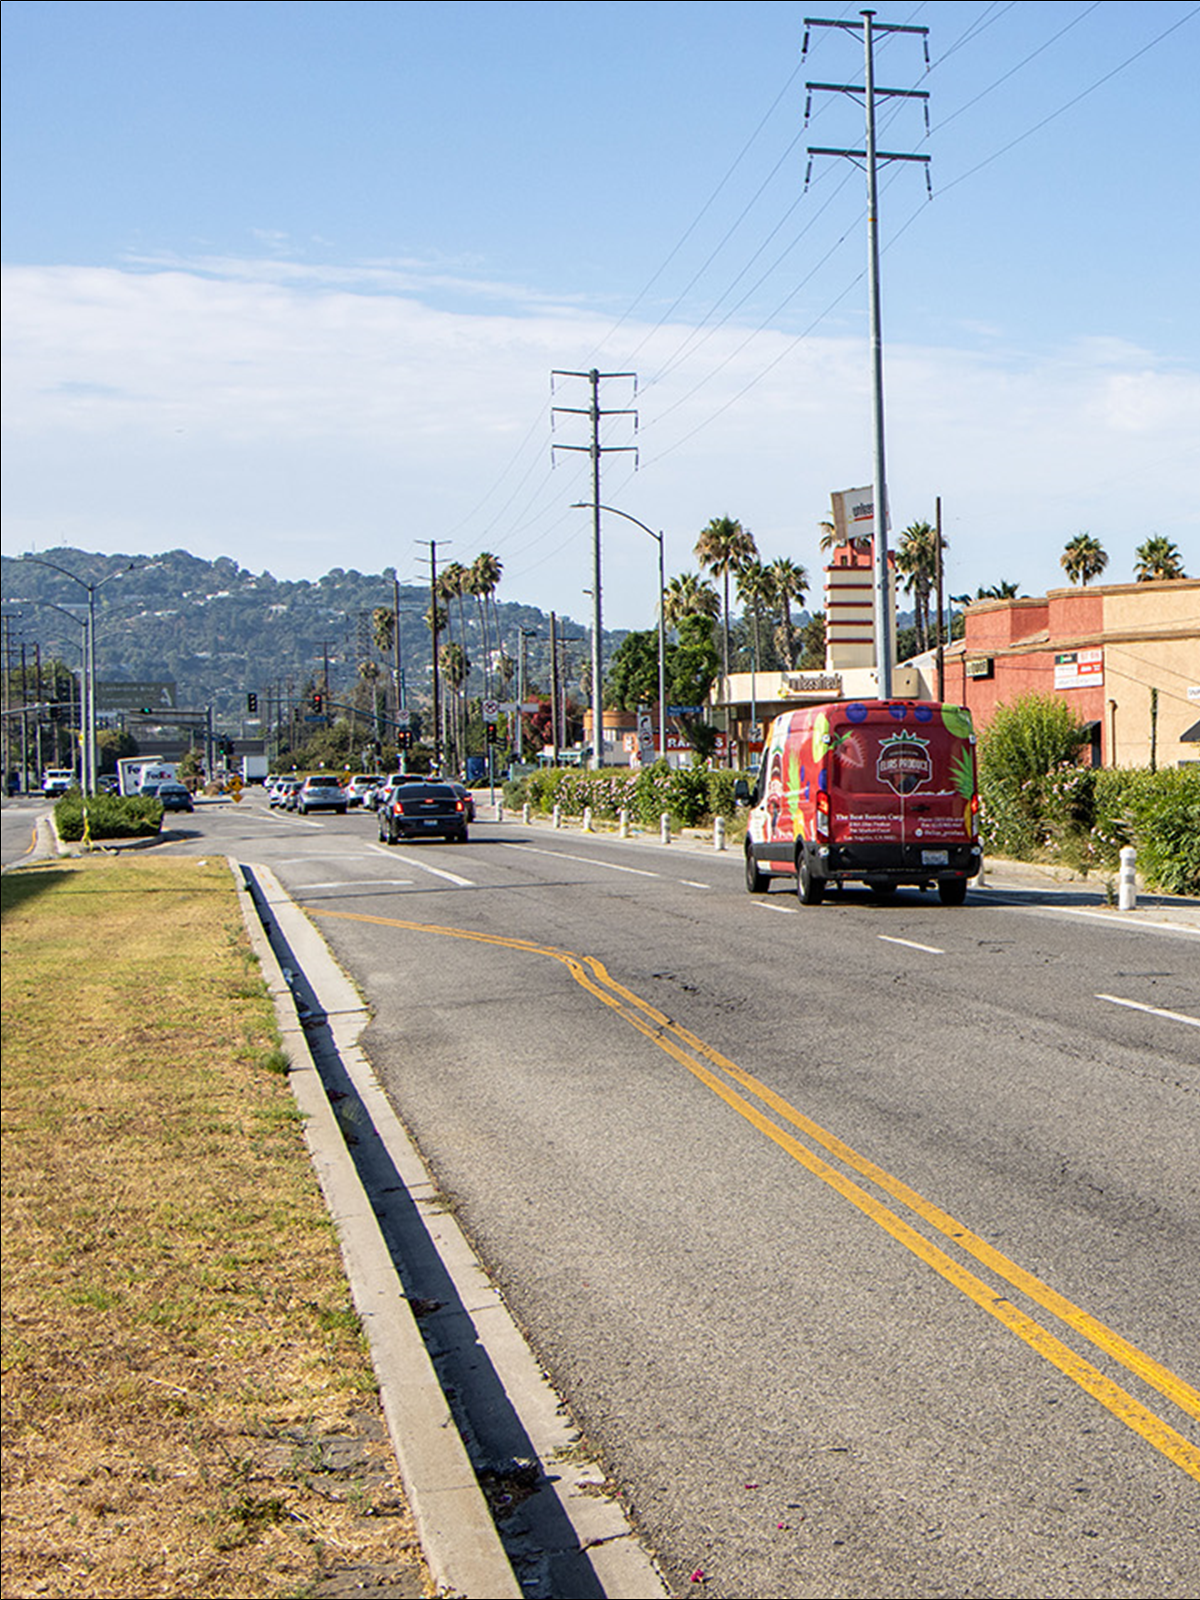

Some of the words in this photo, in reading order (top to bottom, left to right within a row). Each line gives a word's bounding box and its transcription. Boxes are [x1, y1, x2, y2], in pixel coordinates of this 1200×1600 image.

[881, 759, 898, 771] ELIAS
[899, 758, 928, 771] PRODUCE
[147, 771, 171, 779] FedEx
